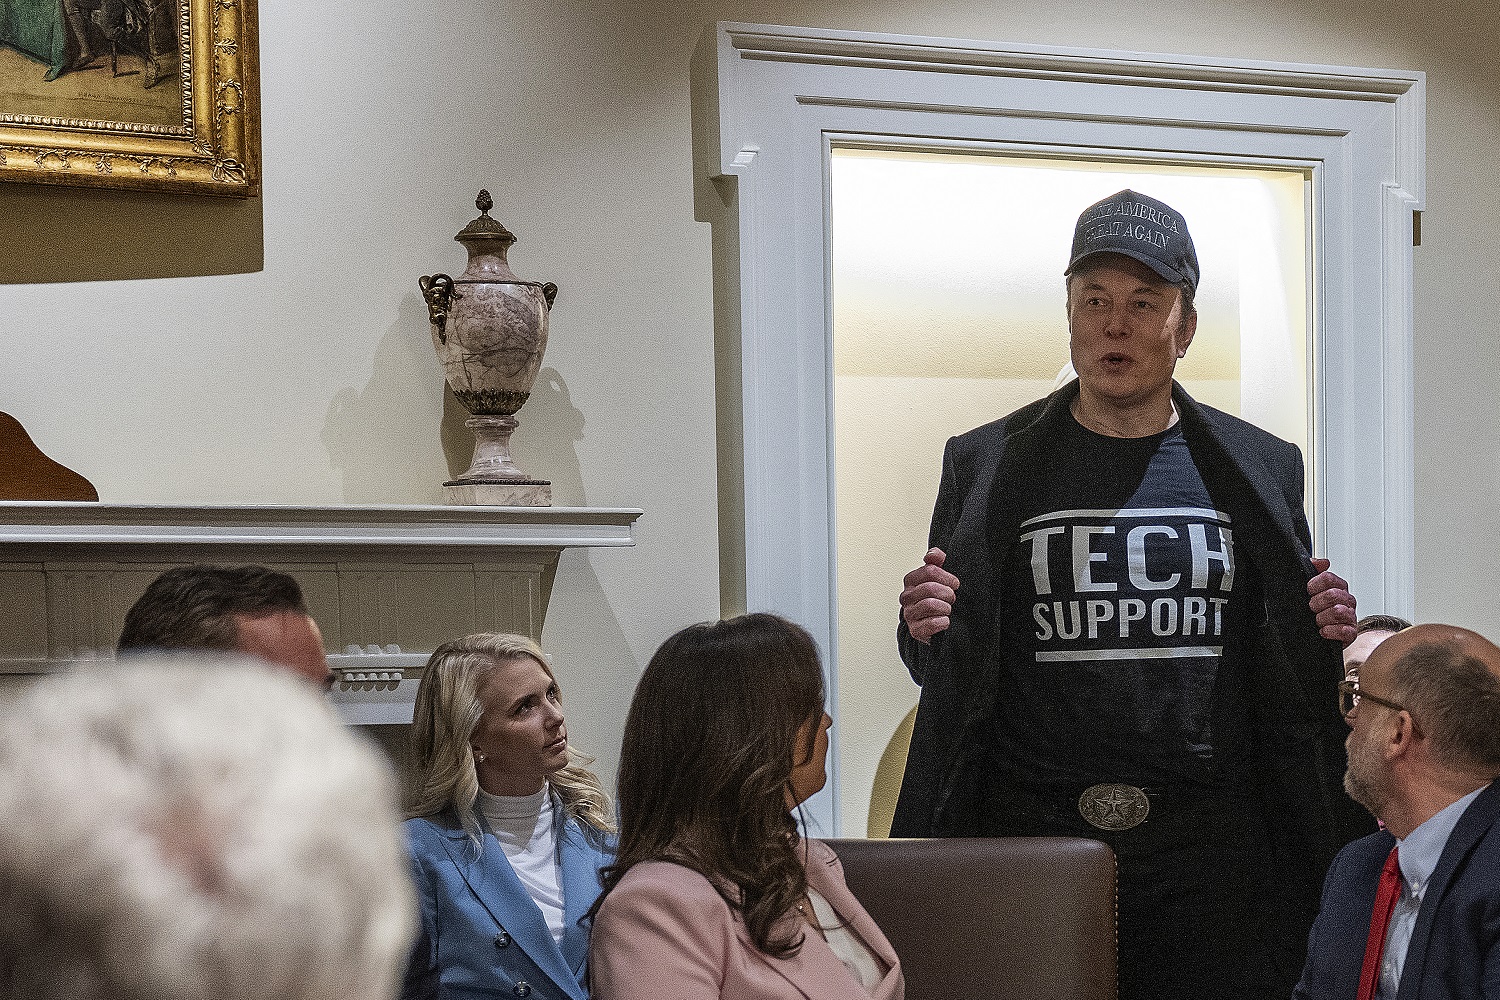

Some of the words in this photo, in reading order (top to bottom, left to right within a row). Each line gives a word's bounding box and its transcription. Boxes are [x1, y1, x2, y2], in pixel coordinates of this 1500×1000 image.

[1114, 201, 1180, 235] AMERICA
[1122, 223, 1171, 251] AGAIN
[1020, 523, 1236, 595] TECH
[1032, 596, 1229, 641] SUPPORT
